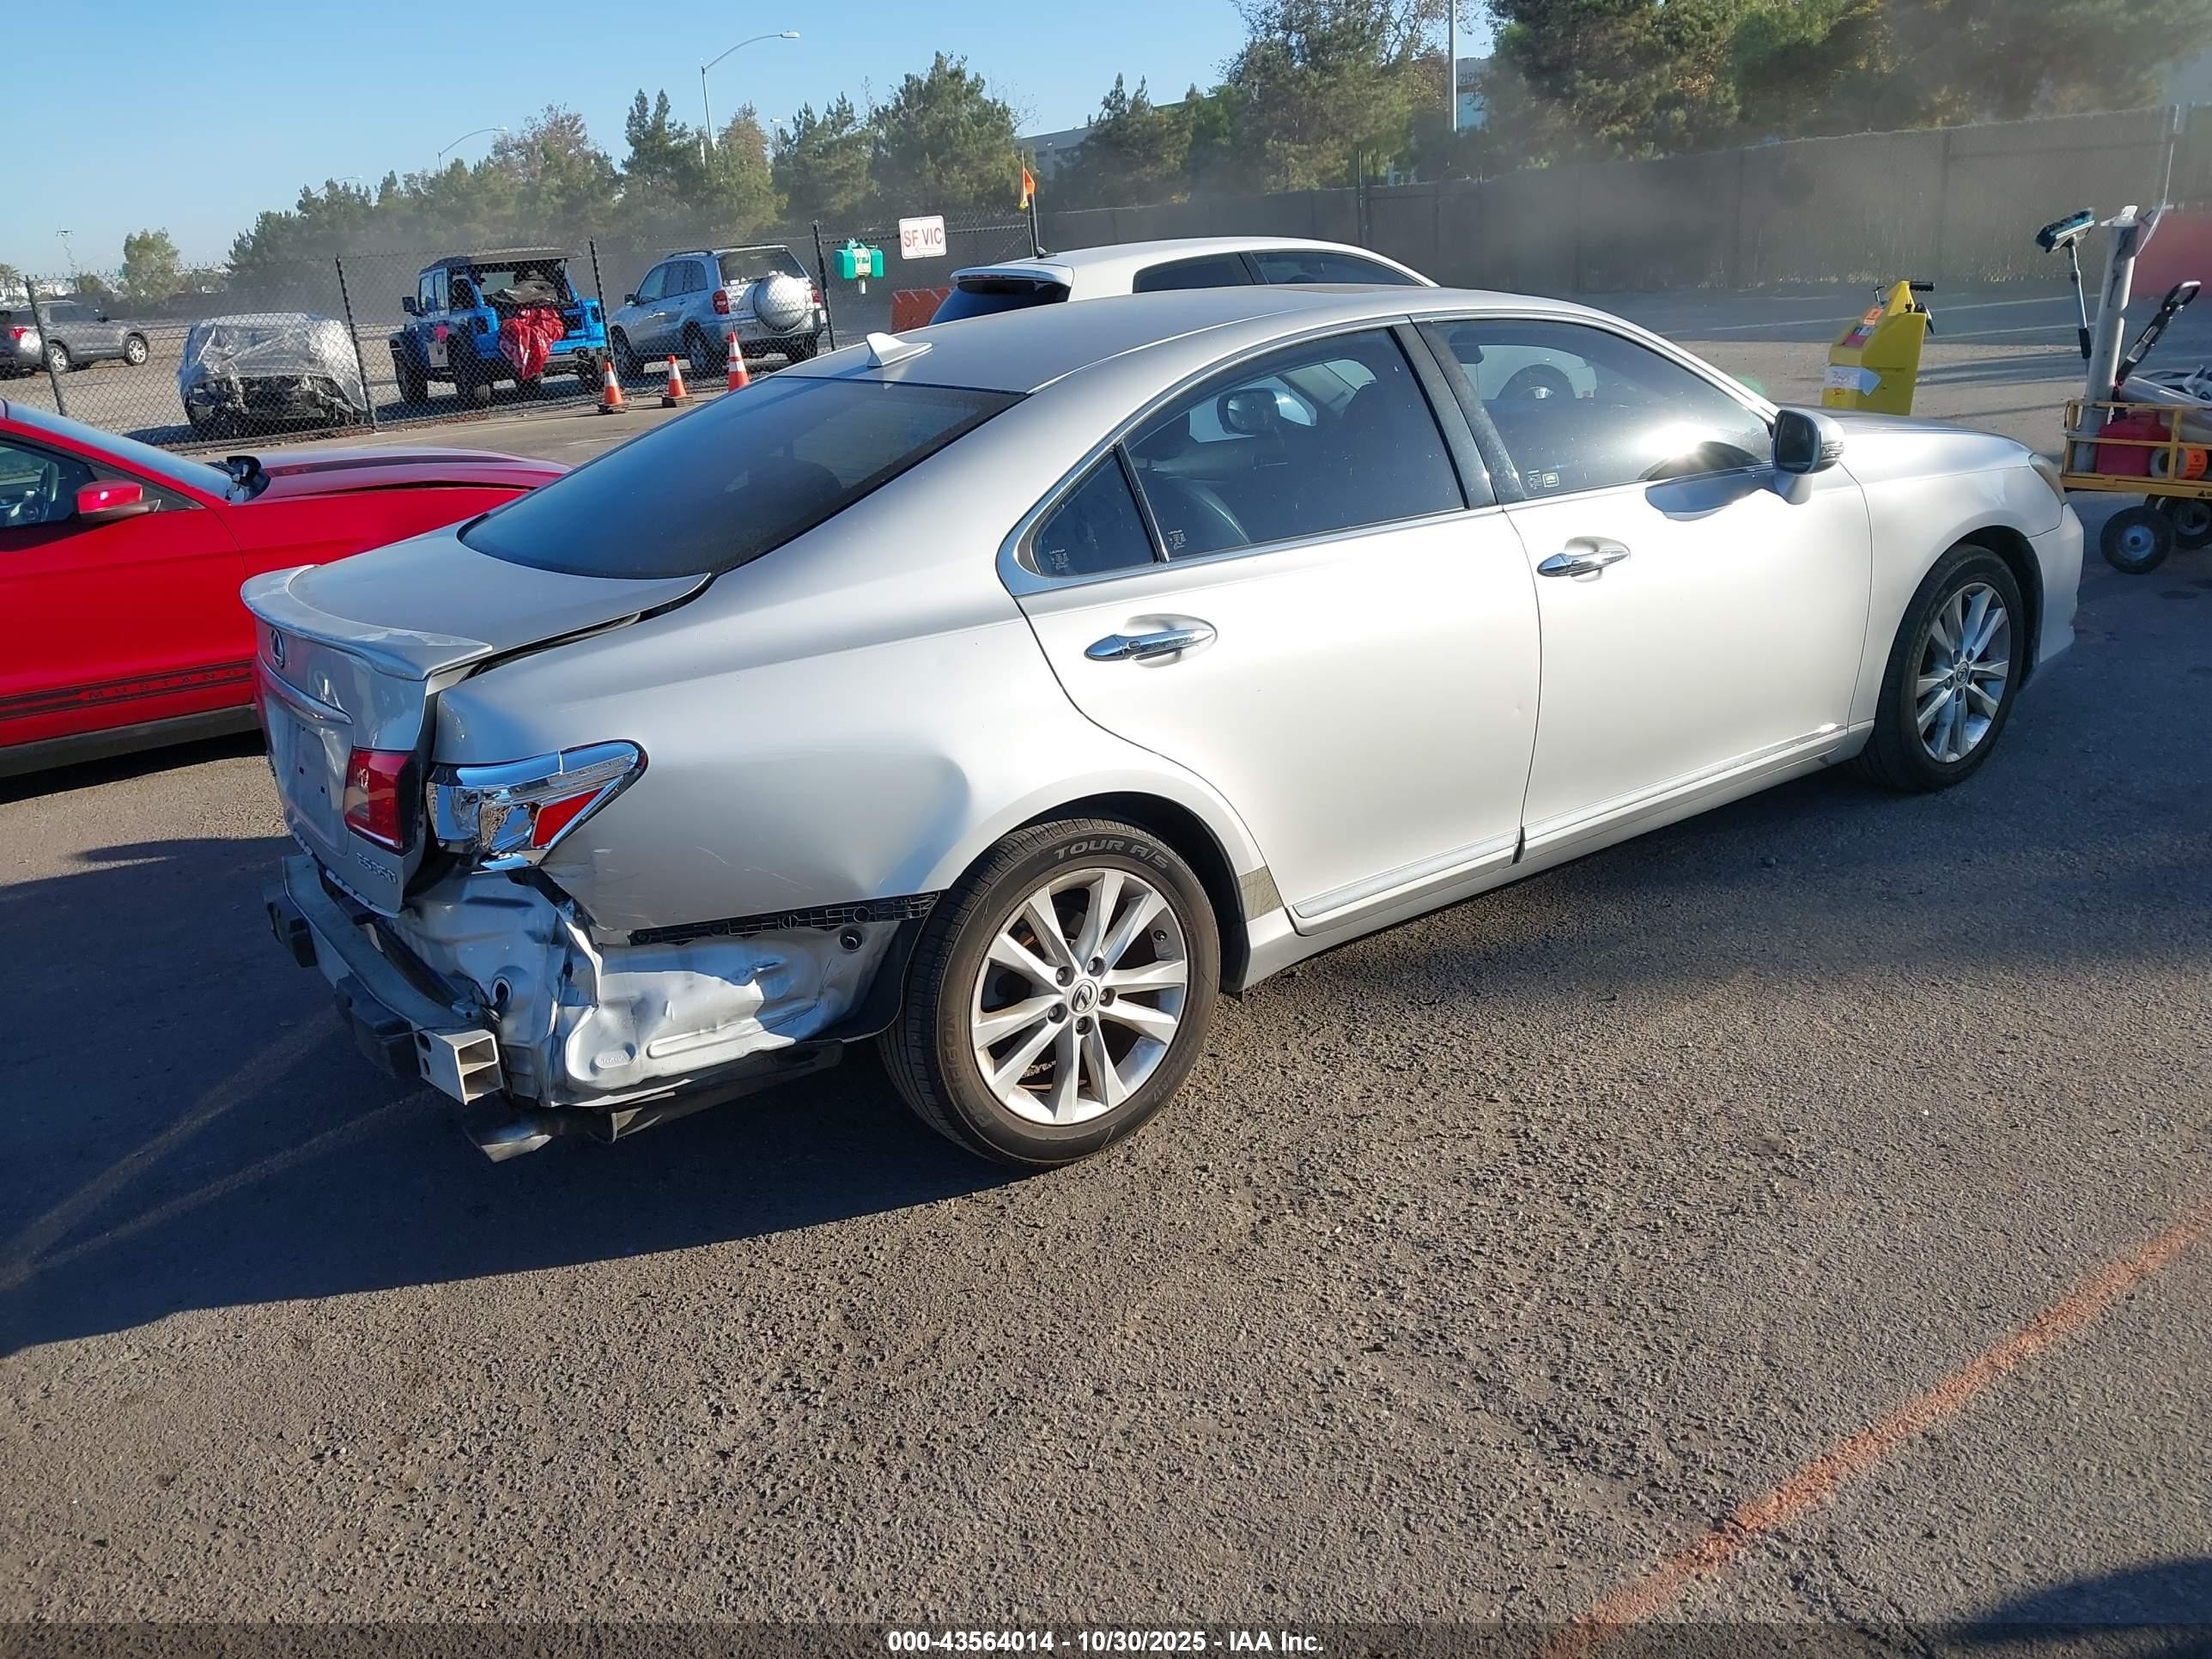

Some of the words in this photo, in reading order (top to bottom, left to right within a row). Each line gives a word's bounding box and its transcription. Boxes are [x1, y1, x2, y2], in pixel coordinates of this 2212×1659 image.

[903, 229, 919, 248] SF
[921, 227, 942, 246] VIC
[1054, 839, 1125, 860] TOUR
[1128, 844, 1169, 869] A/S
